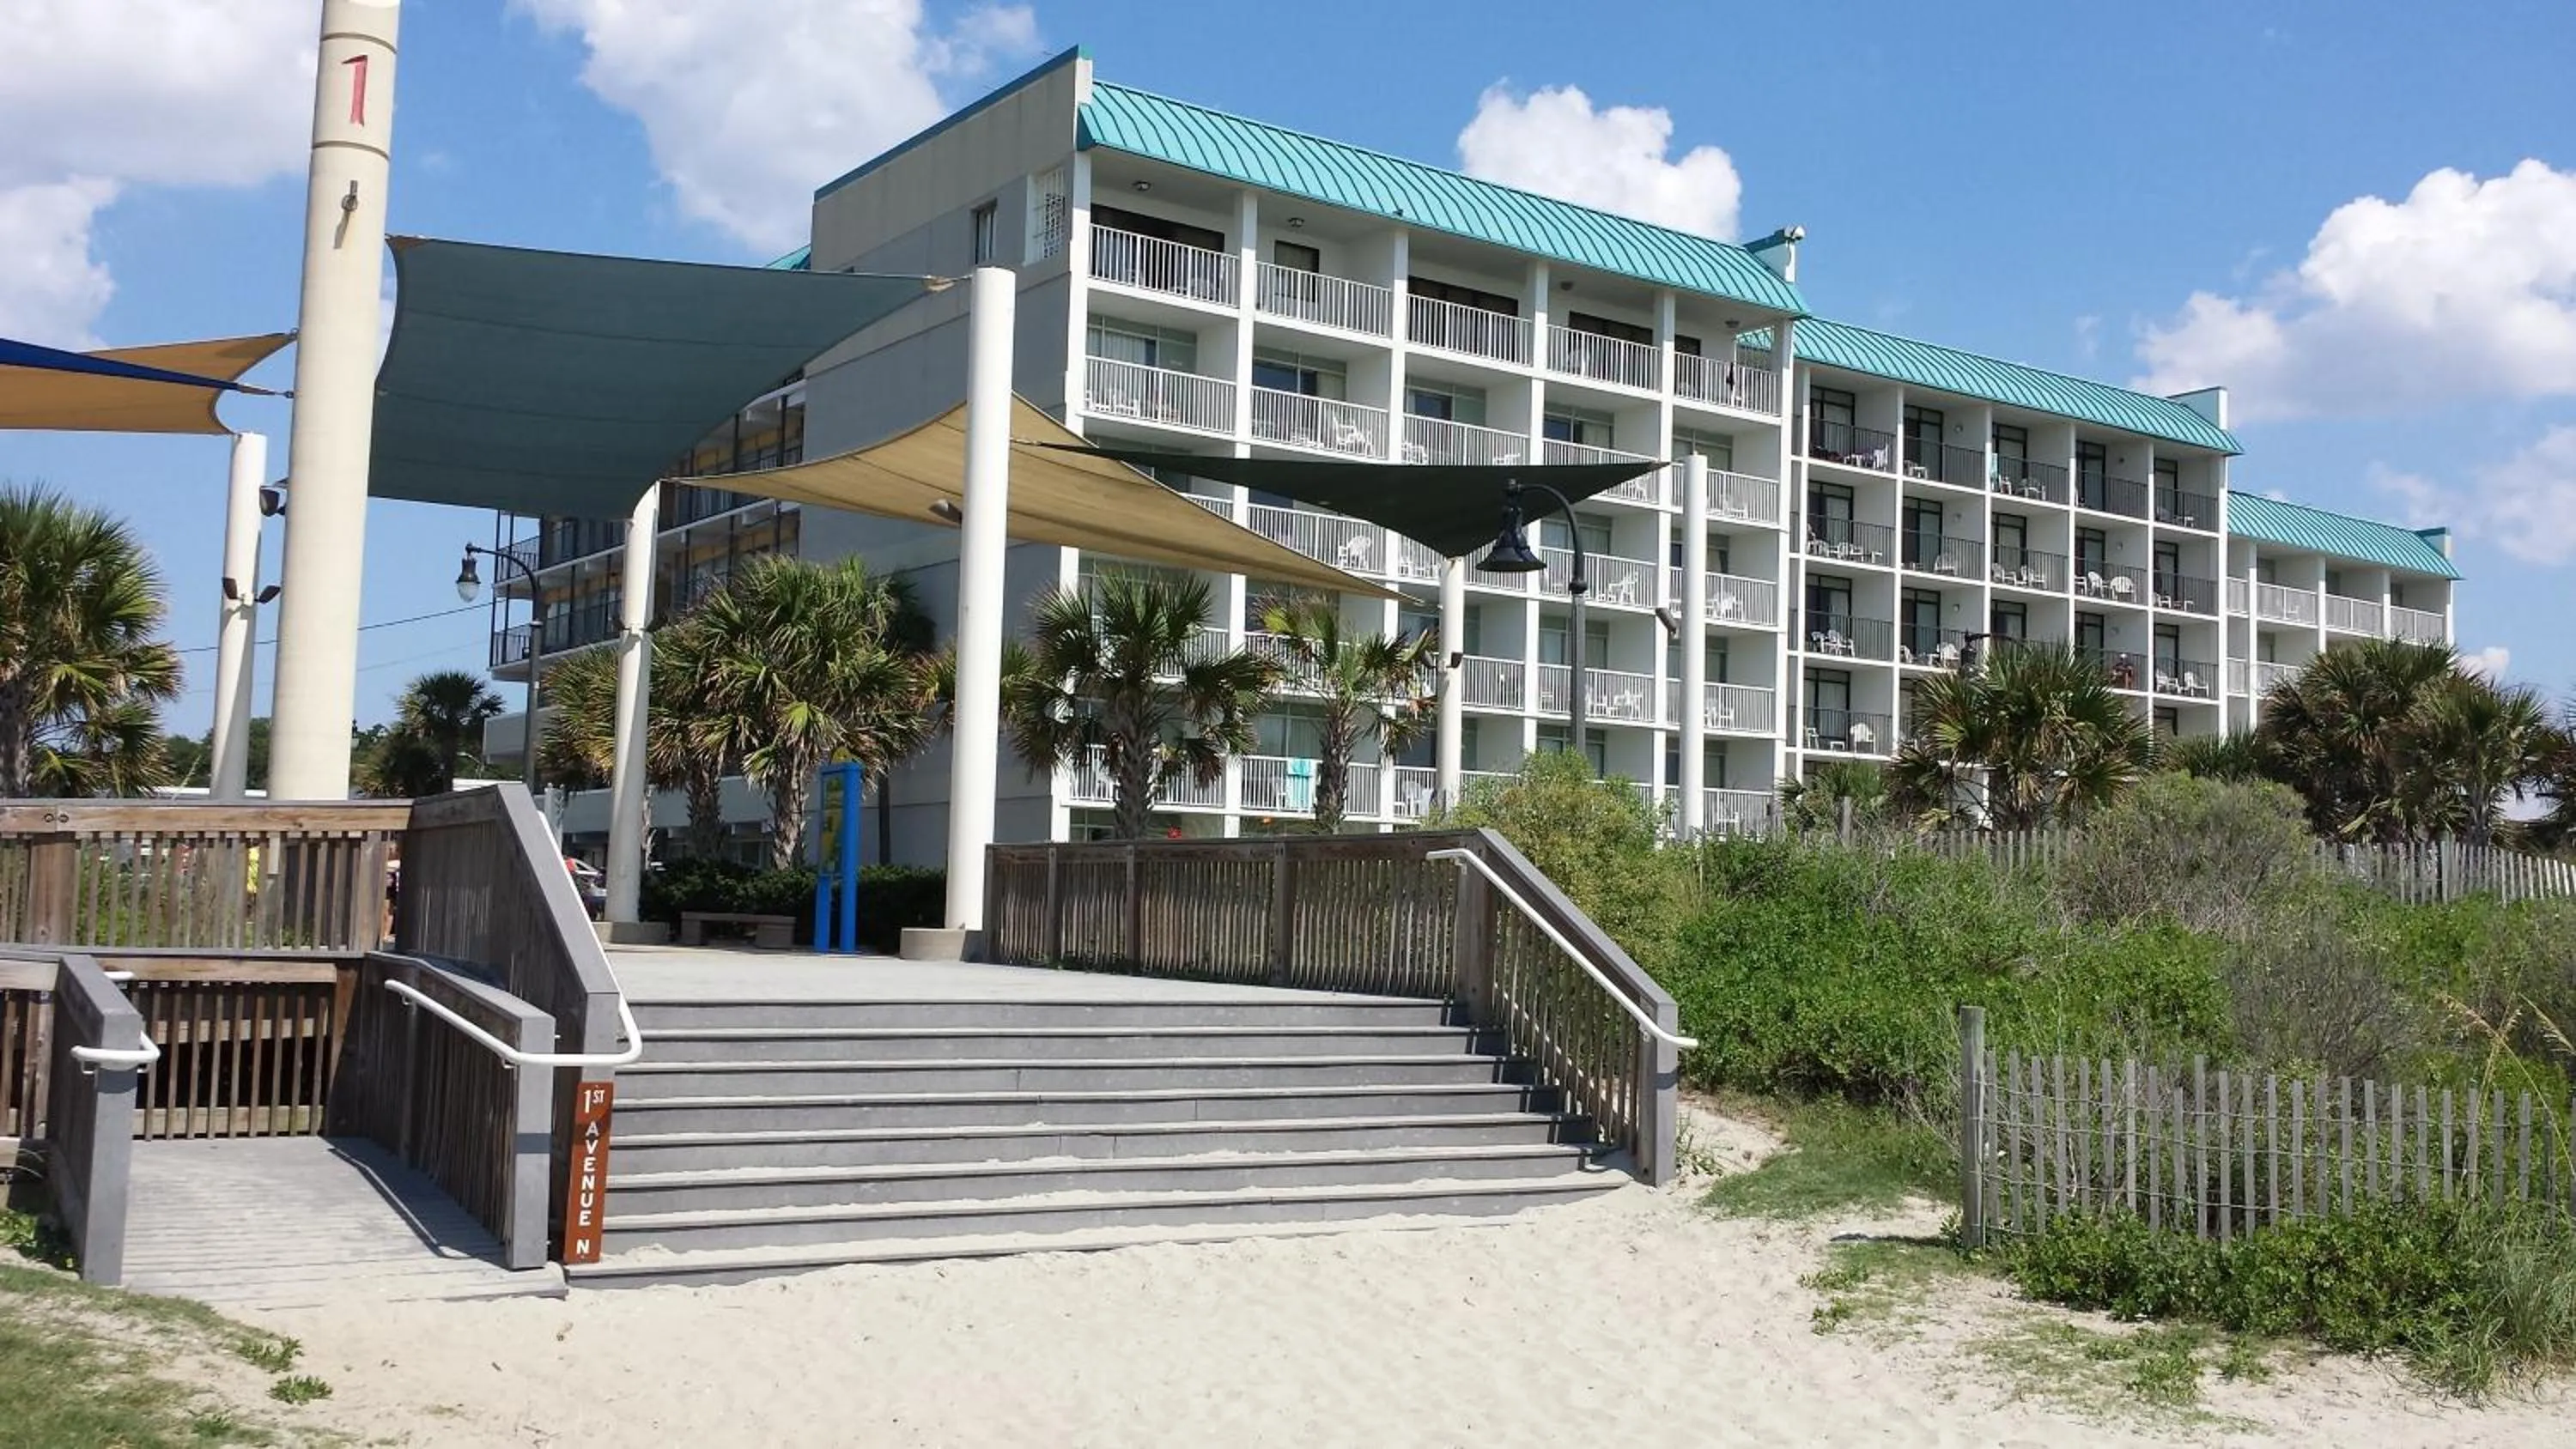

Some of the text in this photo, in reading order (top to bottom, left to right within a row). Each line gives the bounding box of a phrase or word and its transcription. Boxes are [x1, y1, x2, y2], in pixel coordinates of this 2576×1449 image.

[341, 54, 368, 127] 1
[583, 1088, 605, 1113] 1ST
[575, 1120, 600, 1255] AVENUE N
